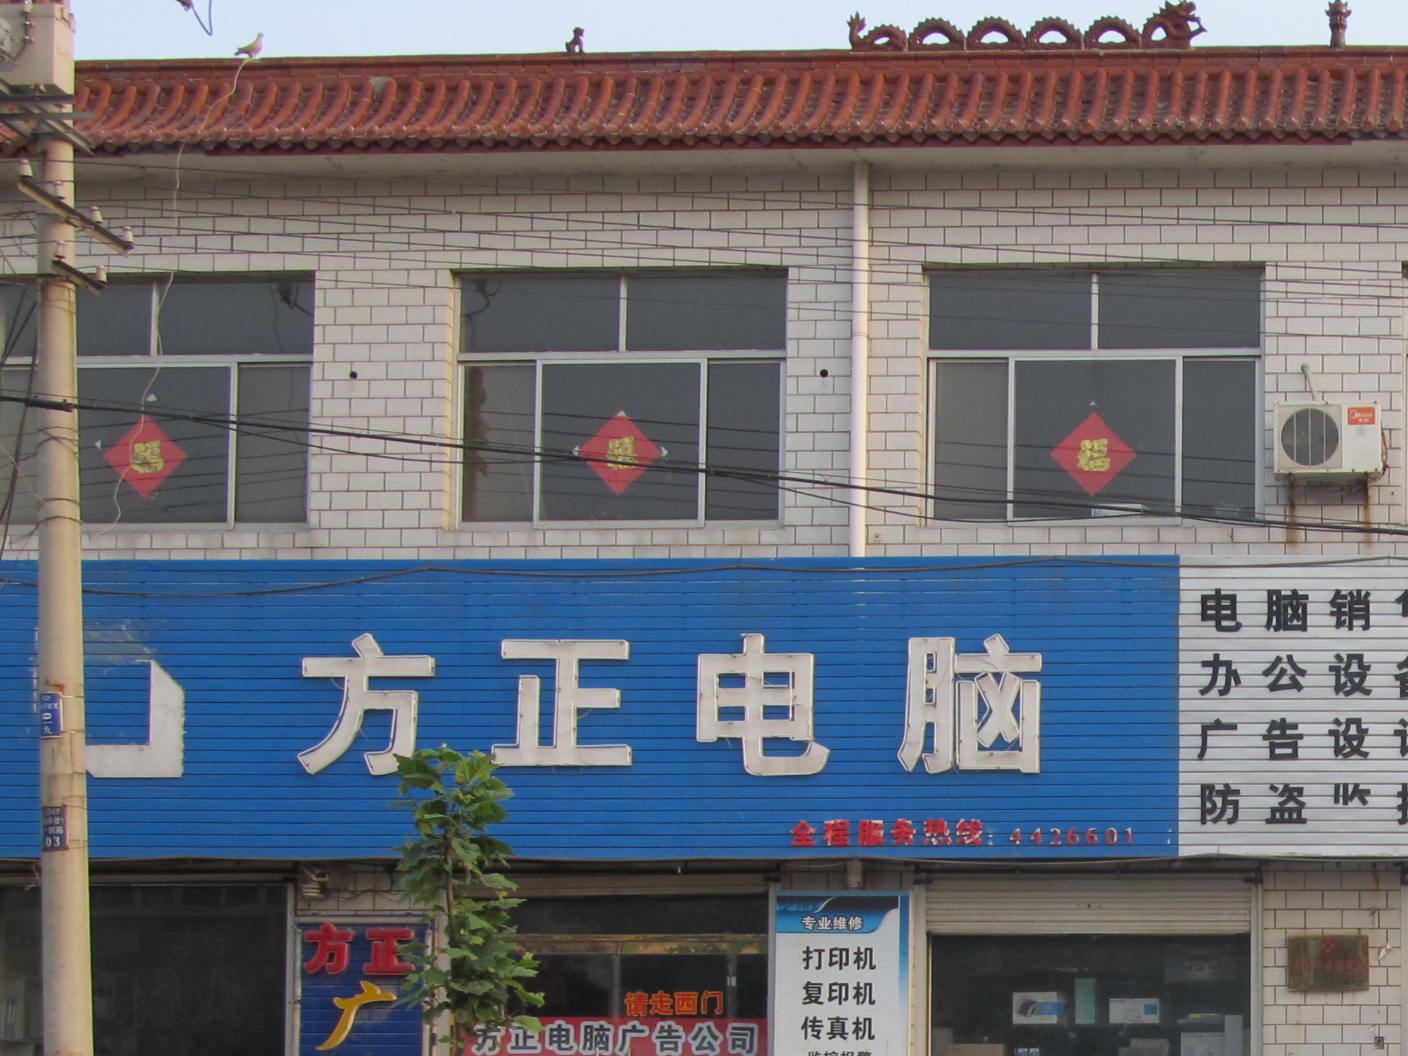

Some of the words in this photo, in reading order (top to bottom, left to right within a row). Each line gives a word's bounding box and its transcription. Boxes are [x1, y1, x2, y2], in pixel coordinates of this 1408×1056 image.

[297, 632, 1044, 776] 方正电脑
[801, 917, 864, 931] 专业维修
[304, 923, 416, 975] 方正
[802, 946, 876, 971] 打印机
[624, 991, 724, 1016] 请走西门
[802, 981, 876, 1006] 复印机
[473, 1022, 759, 1056] 方正电脑广告公司
[801, 1017, 875, 1040] 传真机
